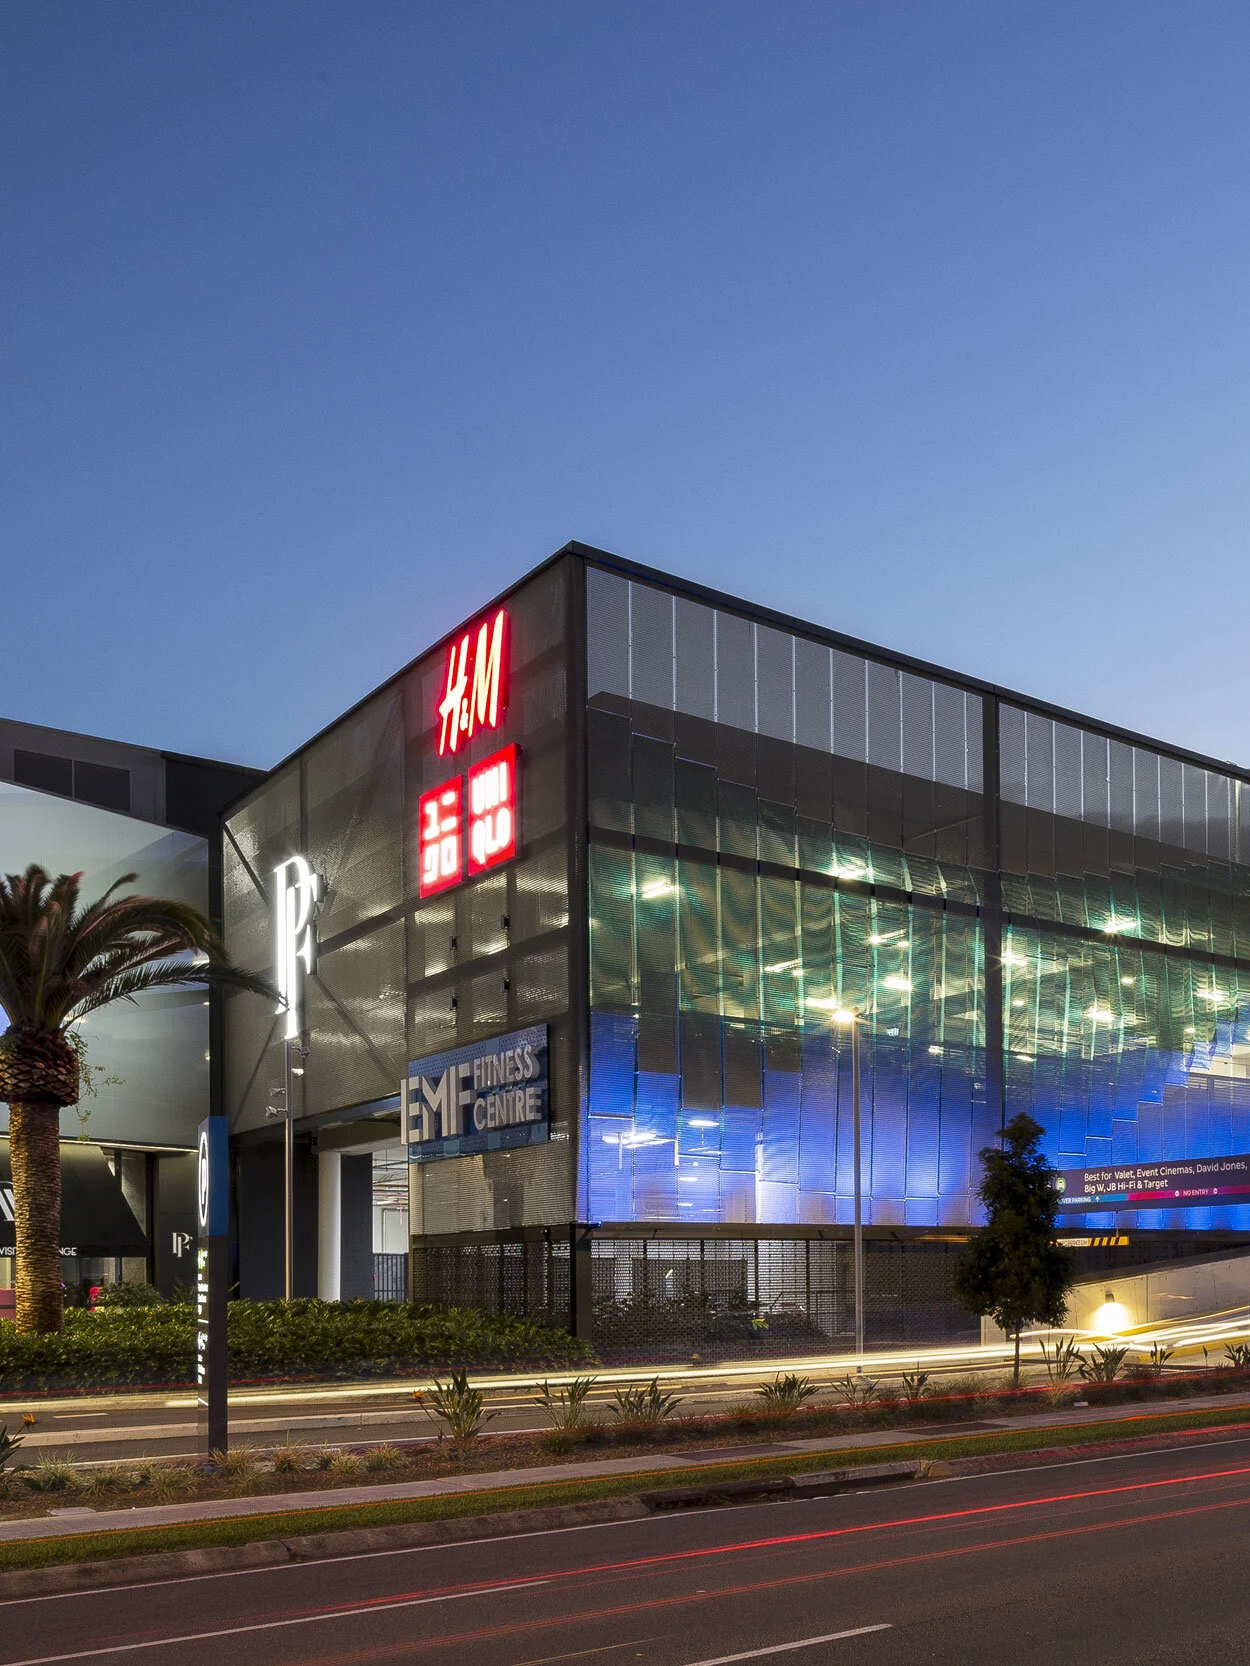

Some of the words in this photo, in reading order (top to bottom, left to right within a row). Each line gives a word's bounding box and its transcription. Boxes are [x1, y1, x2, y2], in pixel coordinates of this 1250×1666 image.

[438, 608, 506, 756] H&M
[473, 1043, 539, 1090] FITNESS
[400, 1062, 471, 1145] EMF
[473, 1087, 541, 1131] CENTRE
[1084, 1172, 1100, 1182] Best
[1101, 1171, 1112, 1181] for
[1114, 1170, 1136, 1180] Valet,
[1137, 1168, 1159, 1178] Event
[1160, 1166, 1195, 1176] Cinemas,
[1196, 1163, 1219, 1173] David
[1220, 1161, 1248, 1171] Jones,
[1084, 1184, 1096, 1194] Big
[1096, 1183, 1106, 1193] W,
[1106, 1182, 1116, 1192] JB
[1117, 1181, 1136, 1191] Hi-Fi
[1137, 1180, 1143, 1189] &
[1143, 1179, 1168, 1189] Target
